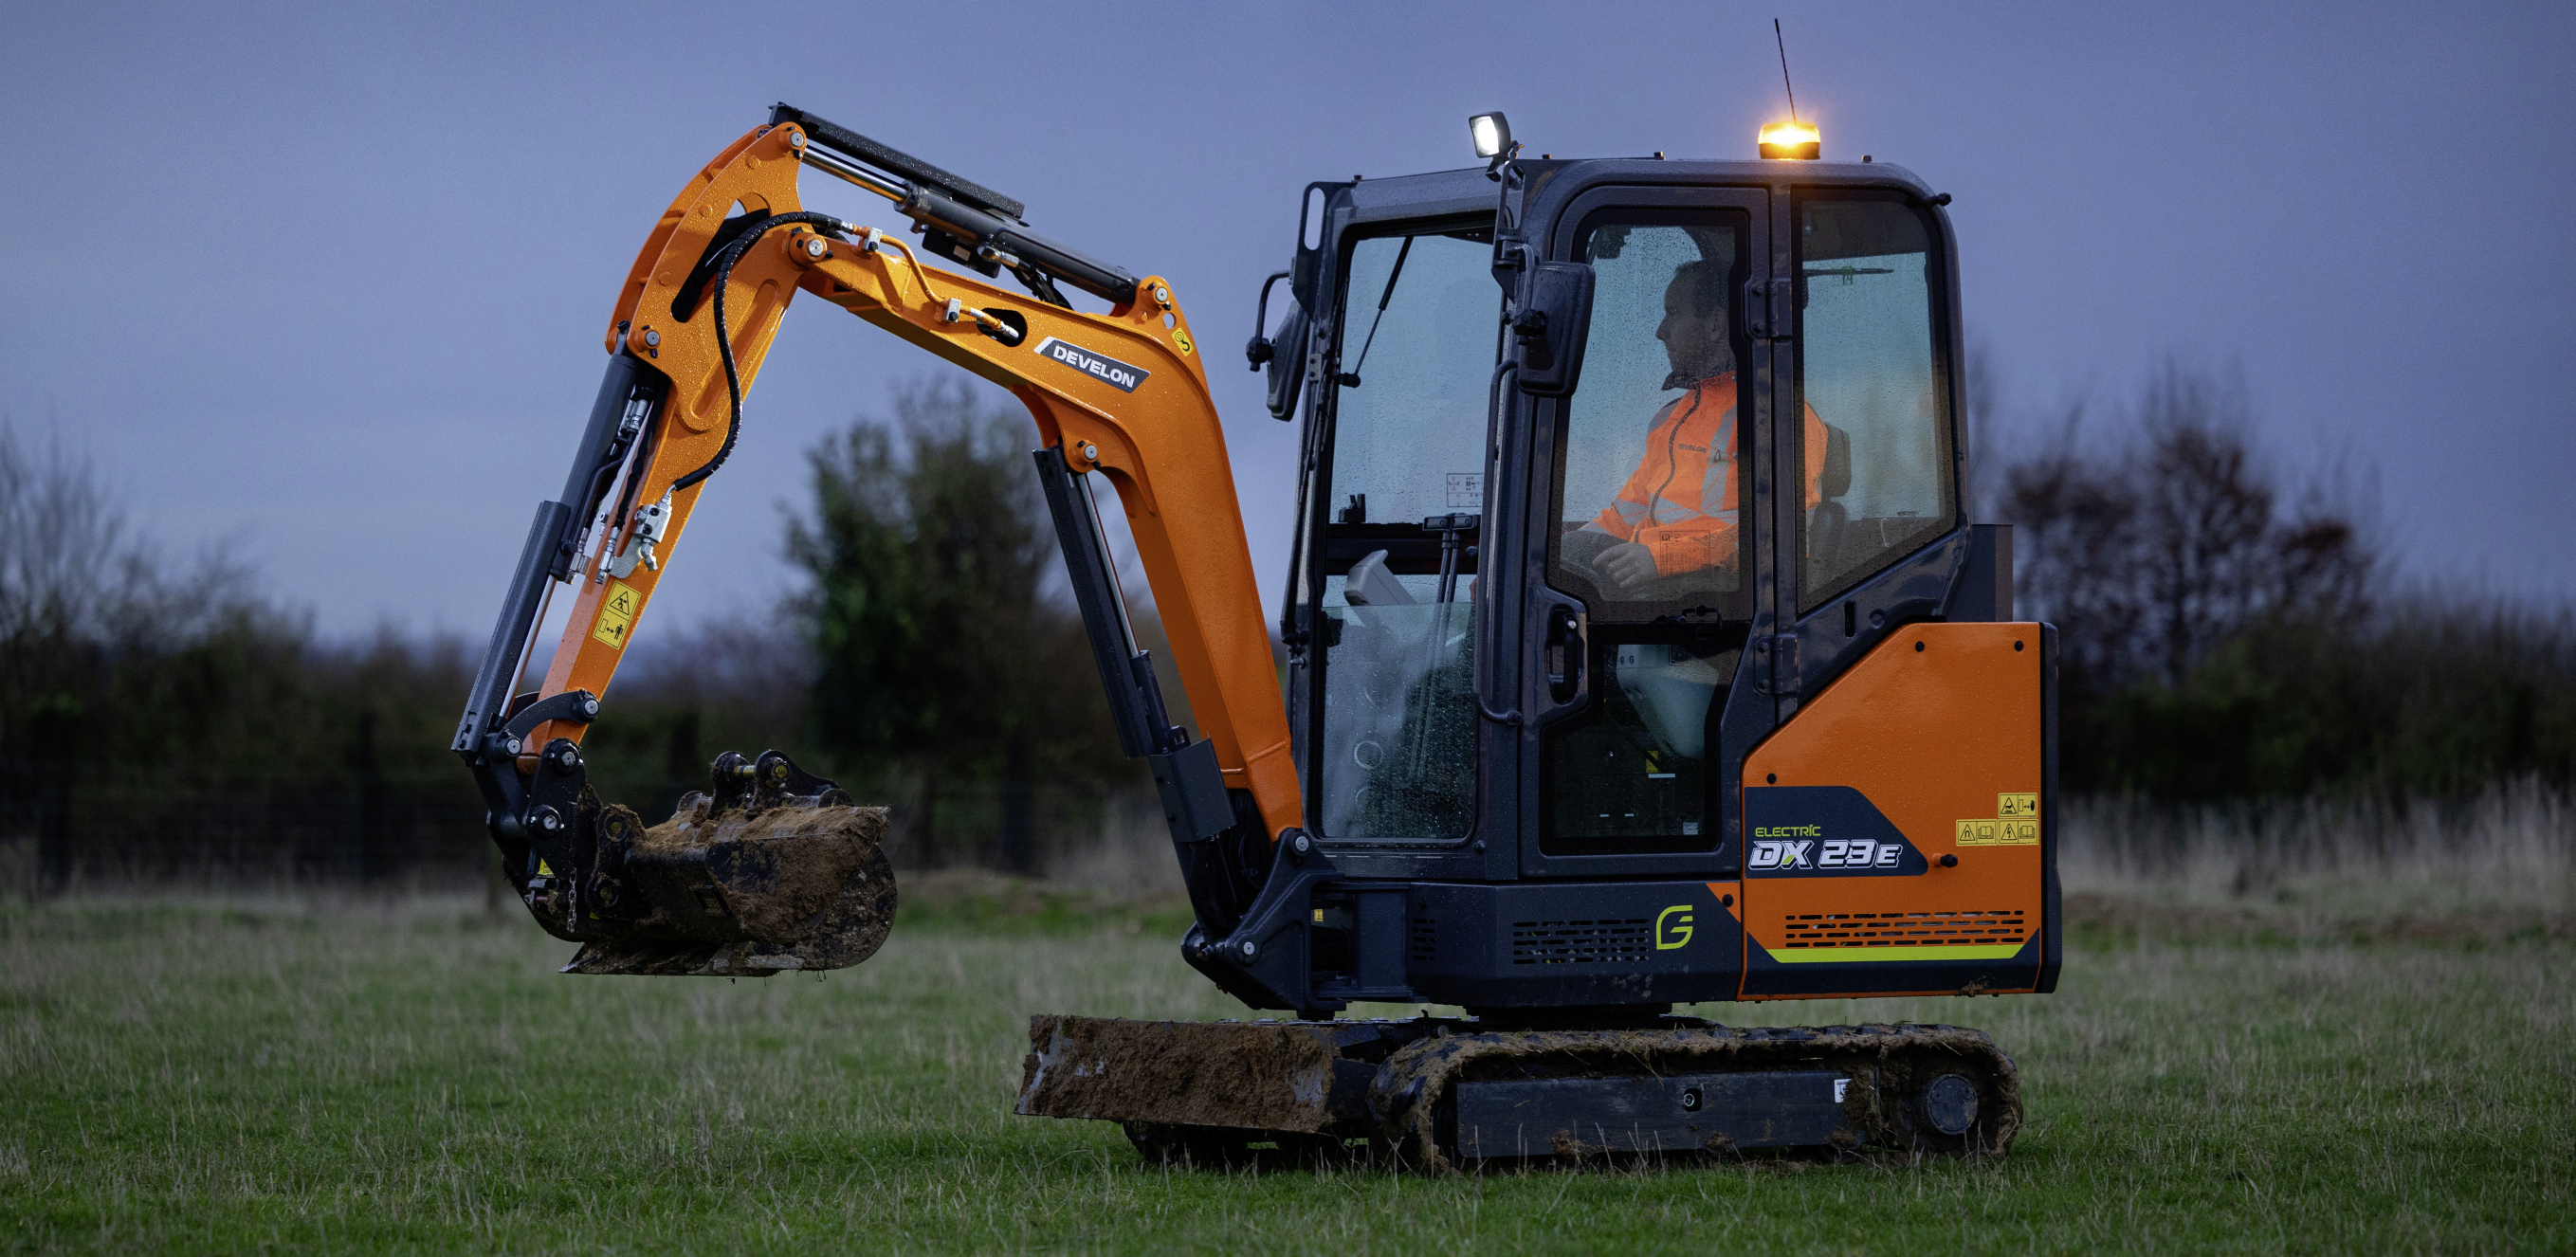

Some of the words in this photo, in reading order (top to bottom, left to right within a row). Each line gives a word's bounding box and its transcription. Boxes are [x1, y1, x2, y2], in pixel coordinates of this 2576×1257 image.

[1053, 345, 1135, 388] DEVELON
[1678, 443, 1708, 453] DEVELON
[1755, 824, 1821, 837] ELECTRIC
[1748, 840, 1815, 870] DX
[1818, 839, 1903, 869] 23E
